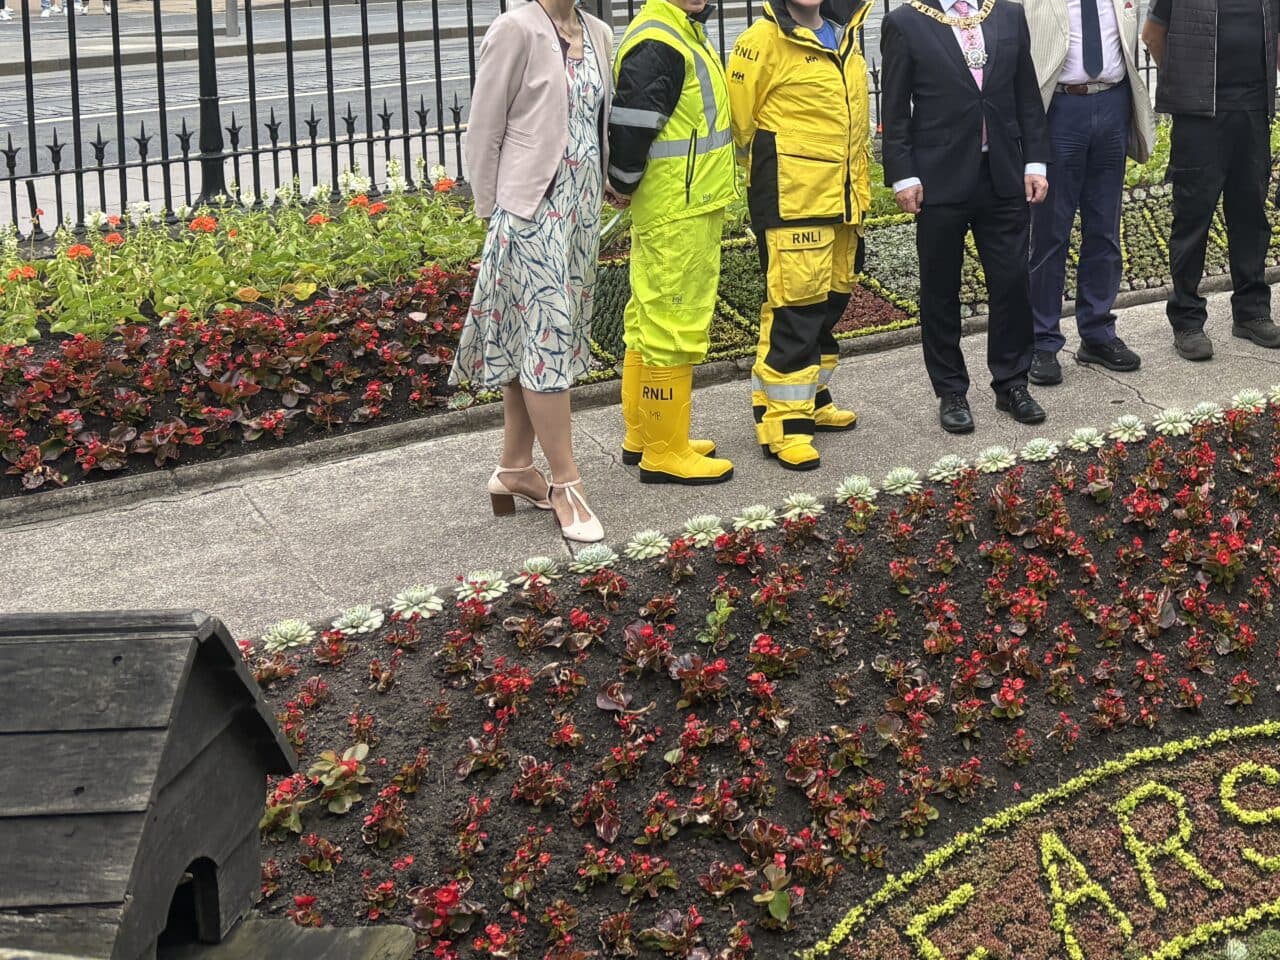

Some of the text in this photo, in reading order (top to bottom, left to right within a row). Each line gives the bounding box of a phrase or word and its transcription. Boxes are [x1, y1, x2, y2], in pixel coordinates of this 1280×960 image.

[734, 44, 760, 62] RNLI
[792, 231, 822, 245] RNLI
[642, 385, 673, 401] RNLI
